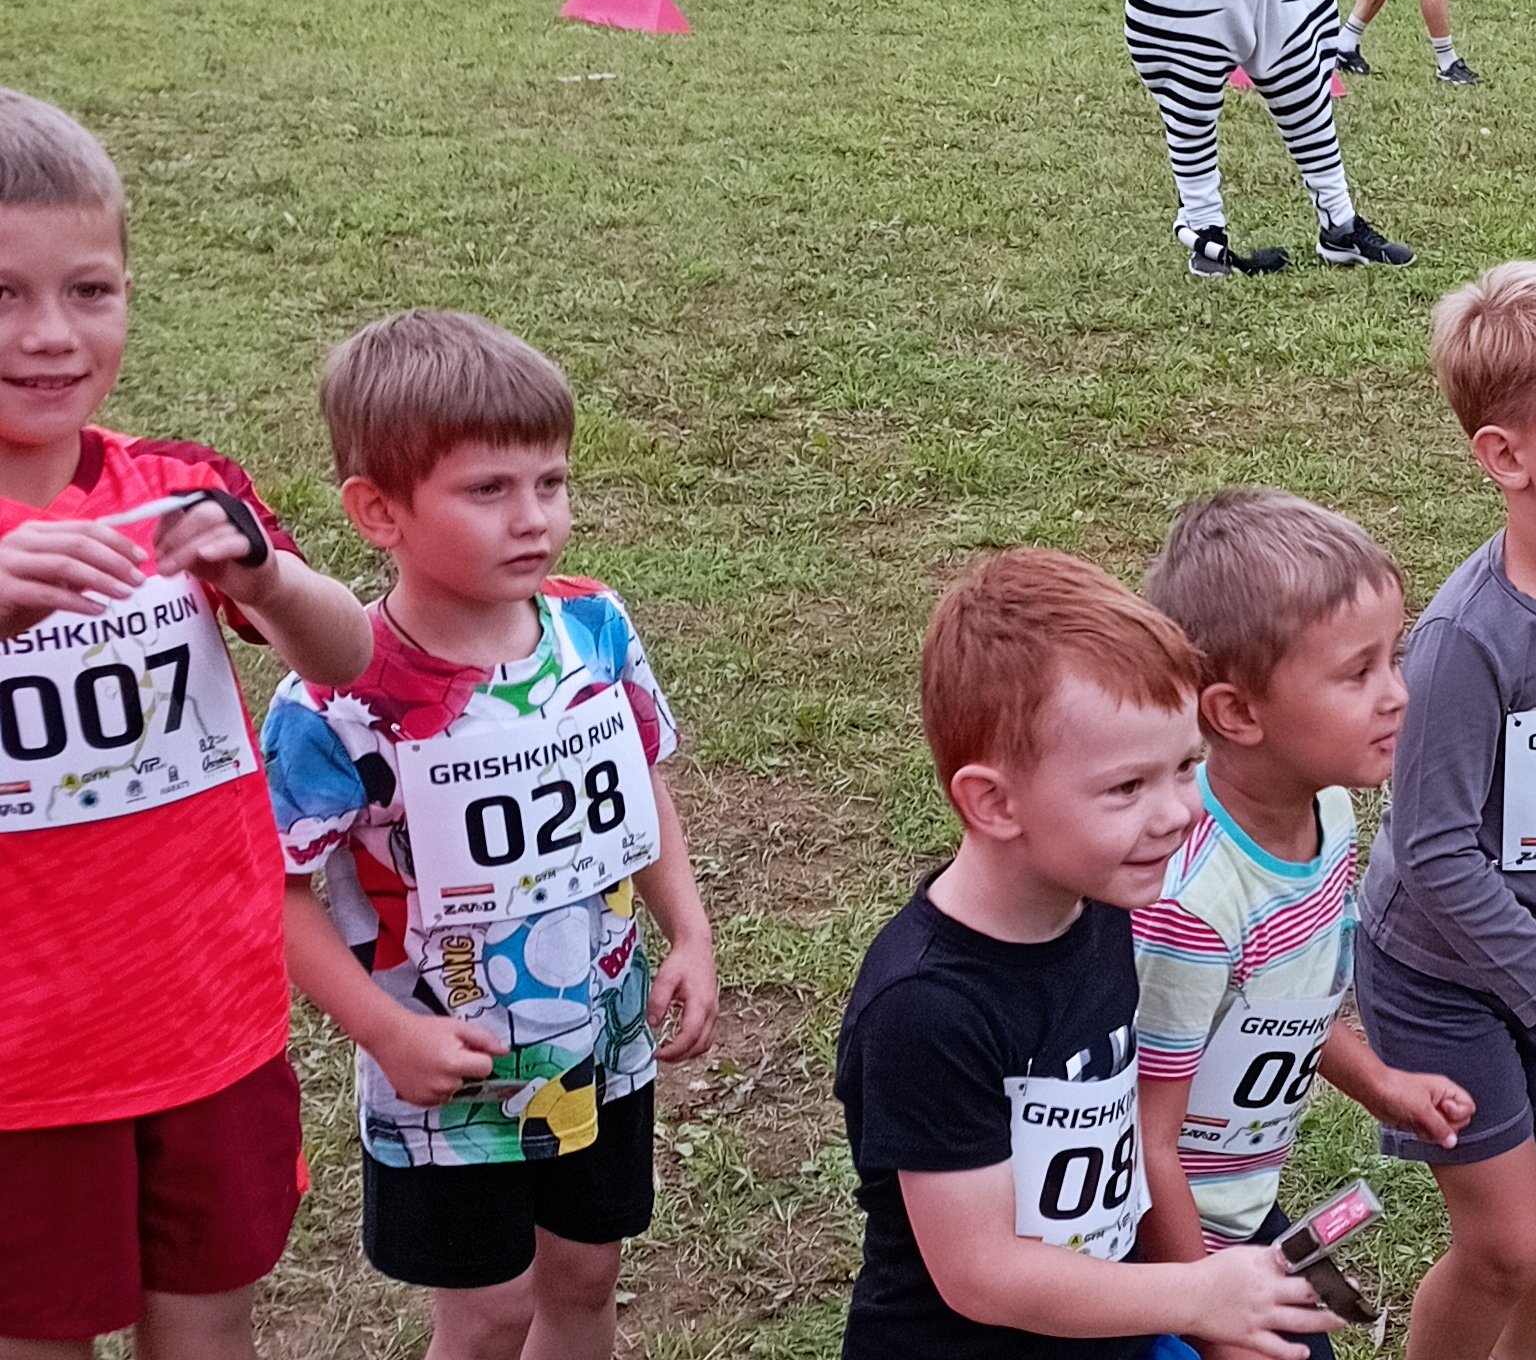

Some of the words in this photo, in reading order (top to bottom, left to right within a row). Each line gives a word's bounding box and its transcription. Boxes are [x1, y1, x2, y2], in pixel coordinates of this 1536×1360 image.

[1, 612, 148, 656] ISHKINO
[155, 593, 200, 630] RUN
[0, 643, 191, 761] 007
[429, 734, 583, 786] GRISHKINO
[588, 711, 625, 748] RUN
[465, 759, 626, 868] 028
[440, 935, 484, 1009] BANG
[1240, 1014, 1332, 1037] GRISHK
[1233, 1039, 1328, 1109] 08
[1039, 1123, 1135, 1221] 08
